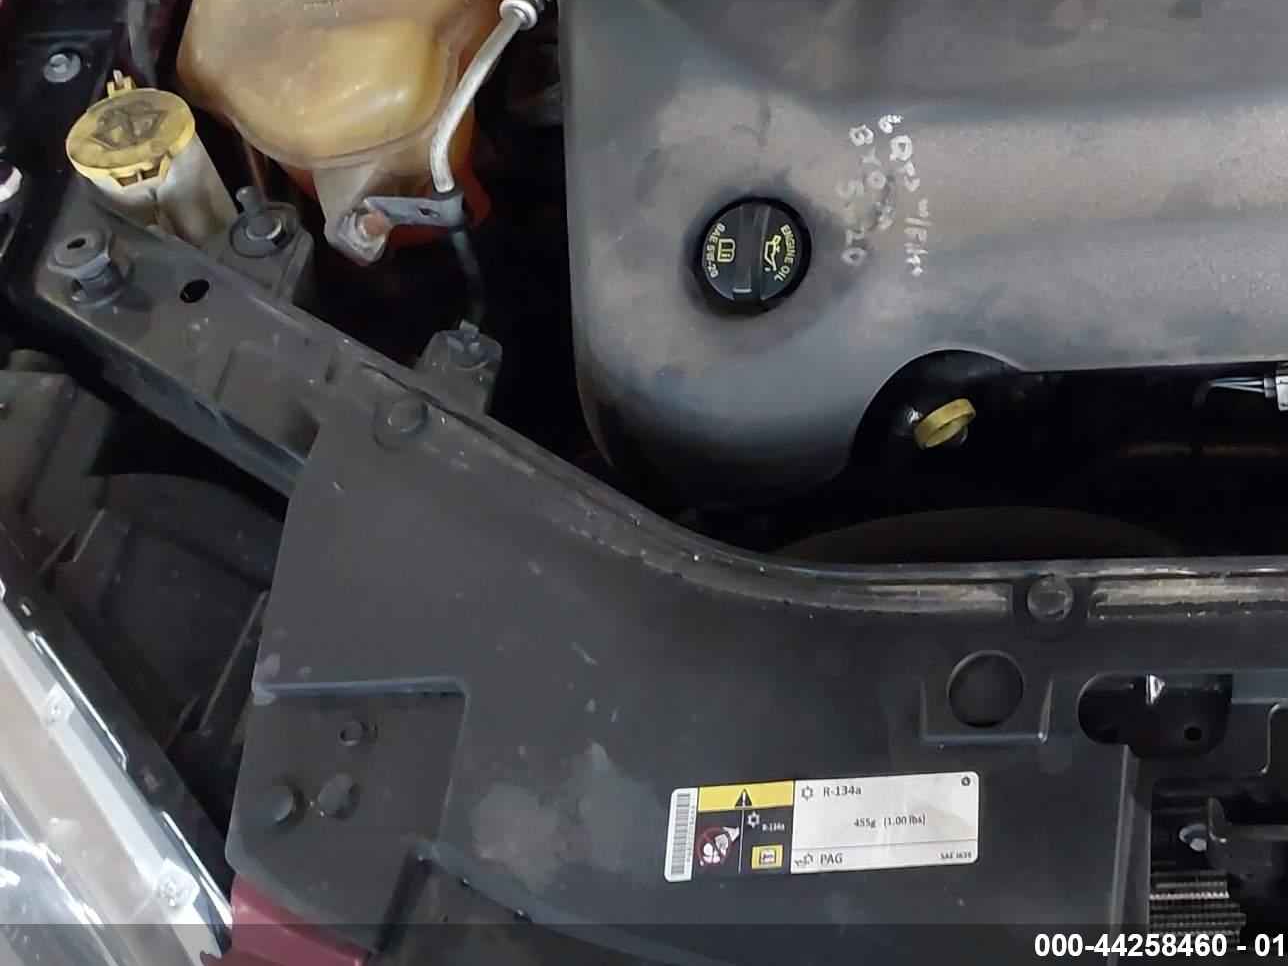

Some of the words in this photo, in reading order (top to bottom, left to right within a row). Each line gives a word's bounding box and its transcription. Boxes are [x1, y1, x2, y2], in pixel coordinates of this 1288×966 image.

[780, 224, 796, 265] ENGINE
[774, 265, 791, 283] OIL
[823, 785, 862, 797] R-134a
[853, 817, 876, 829] 455g
[883, 815, 907, 829] (1.00
[820, 852, 843, 865] PAG
